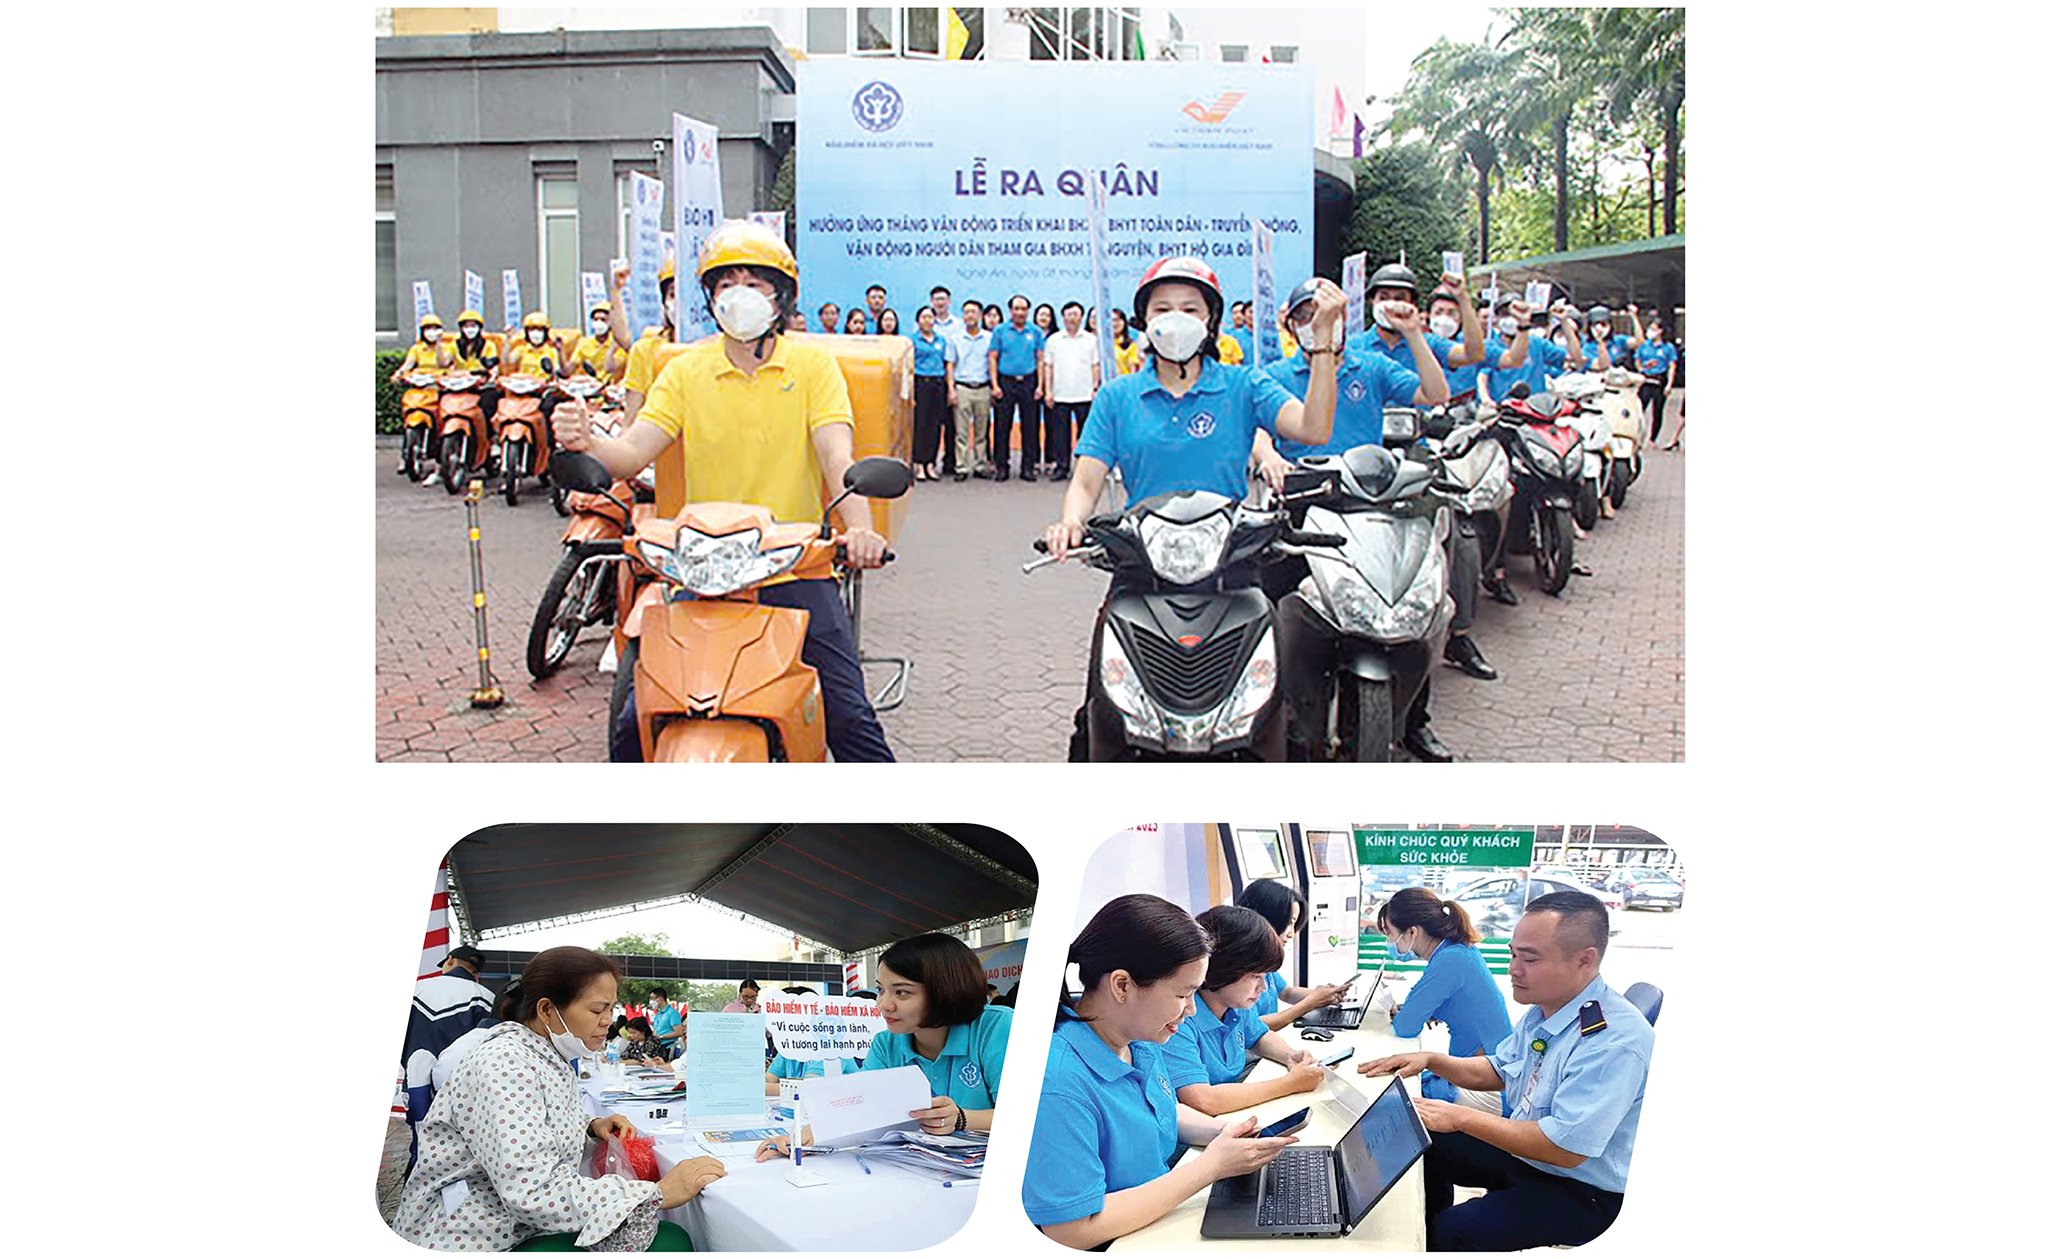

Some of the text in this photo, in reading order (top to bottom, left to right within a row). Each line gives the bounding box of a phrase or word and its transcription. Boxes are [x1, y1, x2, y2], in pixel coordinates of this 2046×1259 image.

[955, 157, 987, 196] LỄ
[1001, 169, 1044, 196] RA
[887, 214, 929, 232] THÁNG
[931, 214, 957, 236] VẬN
[961, 214, 998, 235] ĐỘNG
[1001, 210, 1033, 232] TRIỂN
[1036, 218, 1065, 232] KHAI
[1109, 218, 1137, 232] BHYT
[1140, 213, 1173, 232] TOÀN
[1176, 213, 1202, 232] DÂN
[846, 238, 873, 260] VẬN
[876, 239, 913, 260] ĐỘNG
[915, 240, 956, 257] NGƯỜI
[959, 239, 985, 257] DÂN
[988, 242, 1021, 257] THAM
[1024, 242, 1047, 257] GIA
[1050, 242, 1084, 257] BHXH
[1159, 242, 1187, 257] BHYT
[1190, 238, 1209, 259] HỘ
[1212, 242, 1234, 257] GIA
[1365, 833, 1520, 848] KÍNH CHÚC QUÝ KHÁCH
[1400, 849, 1468, 864] SỨC KHỎE
[1002, 964, 1023, 979] DỊCH
[766, 999, 781, 1014] BẢO
[783, 999, 801, 1015] HIỂM
[803, 1003, 809, 1015] Y
[810, 1001, 819, 1016] TẾ
[825, 1002, 839, 1016] BẢO
[841, 1002, 858, 1017] HIỂM
[860, 1004, 869, 1017] XÃ
[788, 1022, 810, 1034] cuộc
[812, 1021, 834, 1035] sống
[837, 1024, 847, 1033] an
[849, 1023, 870, 1034] lành,
[781, 1038, 790, 1049] vì
[792, 1039, 818, 1051] tương
[820, 1039, 831, 1049] lai
[833, 1039, 855, 1051] hạnh
